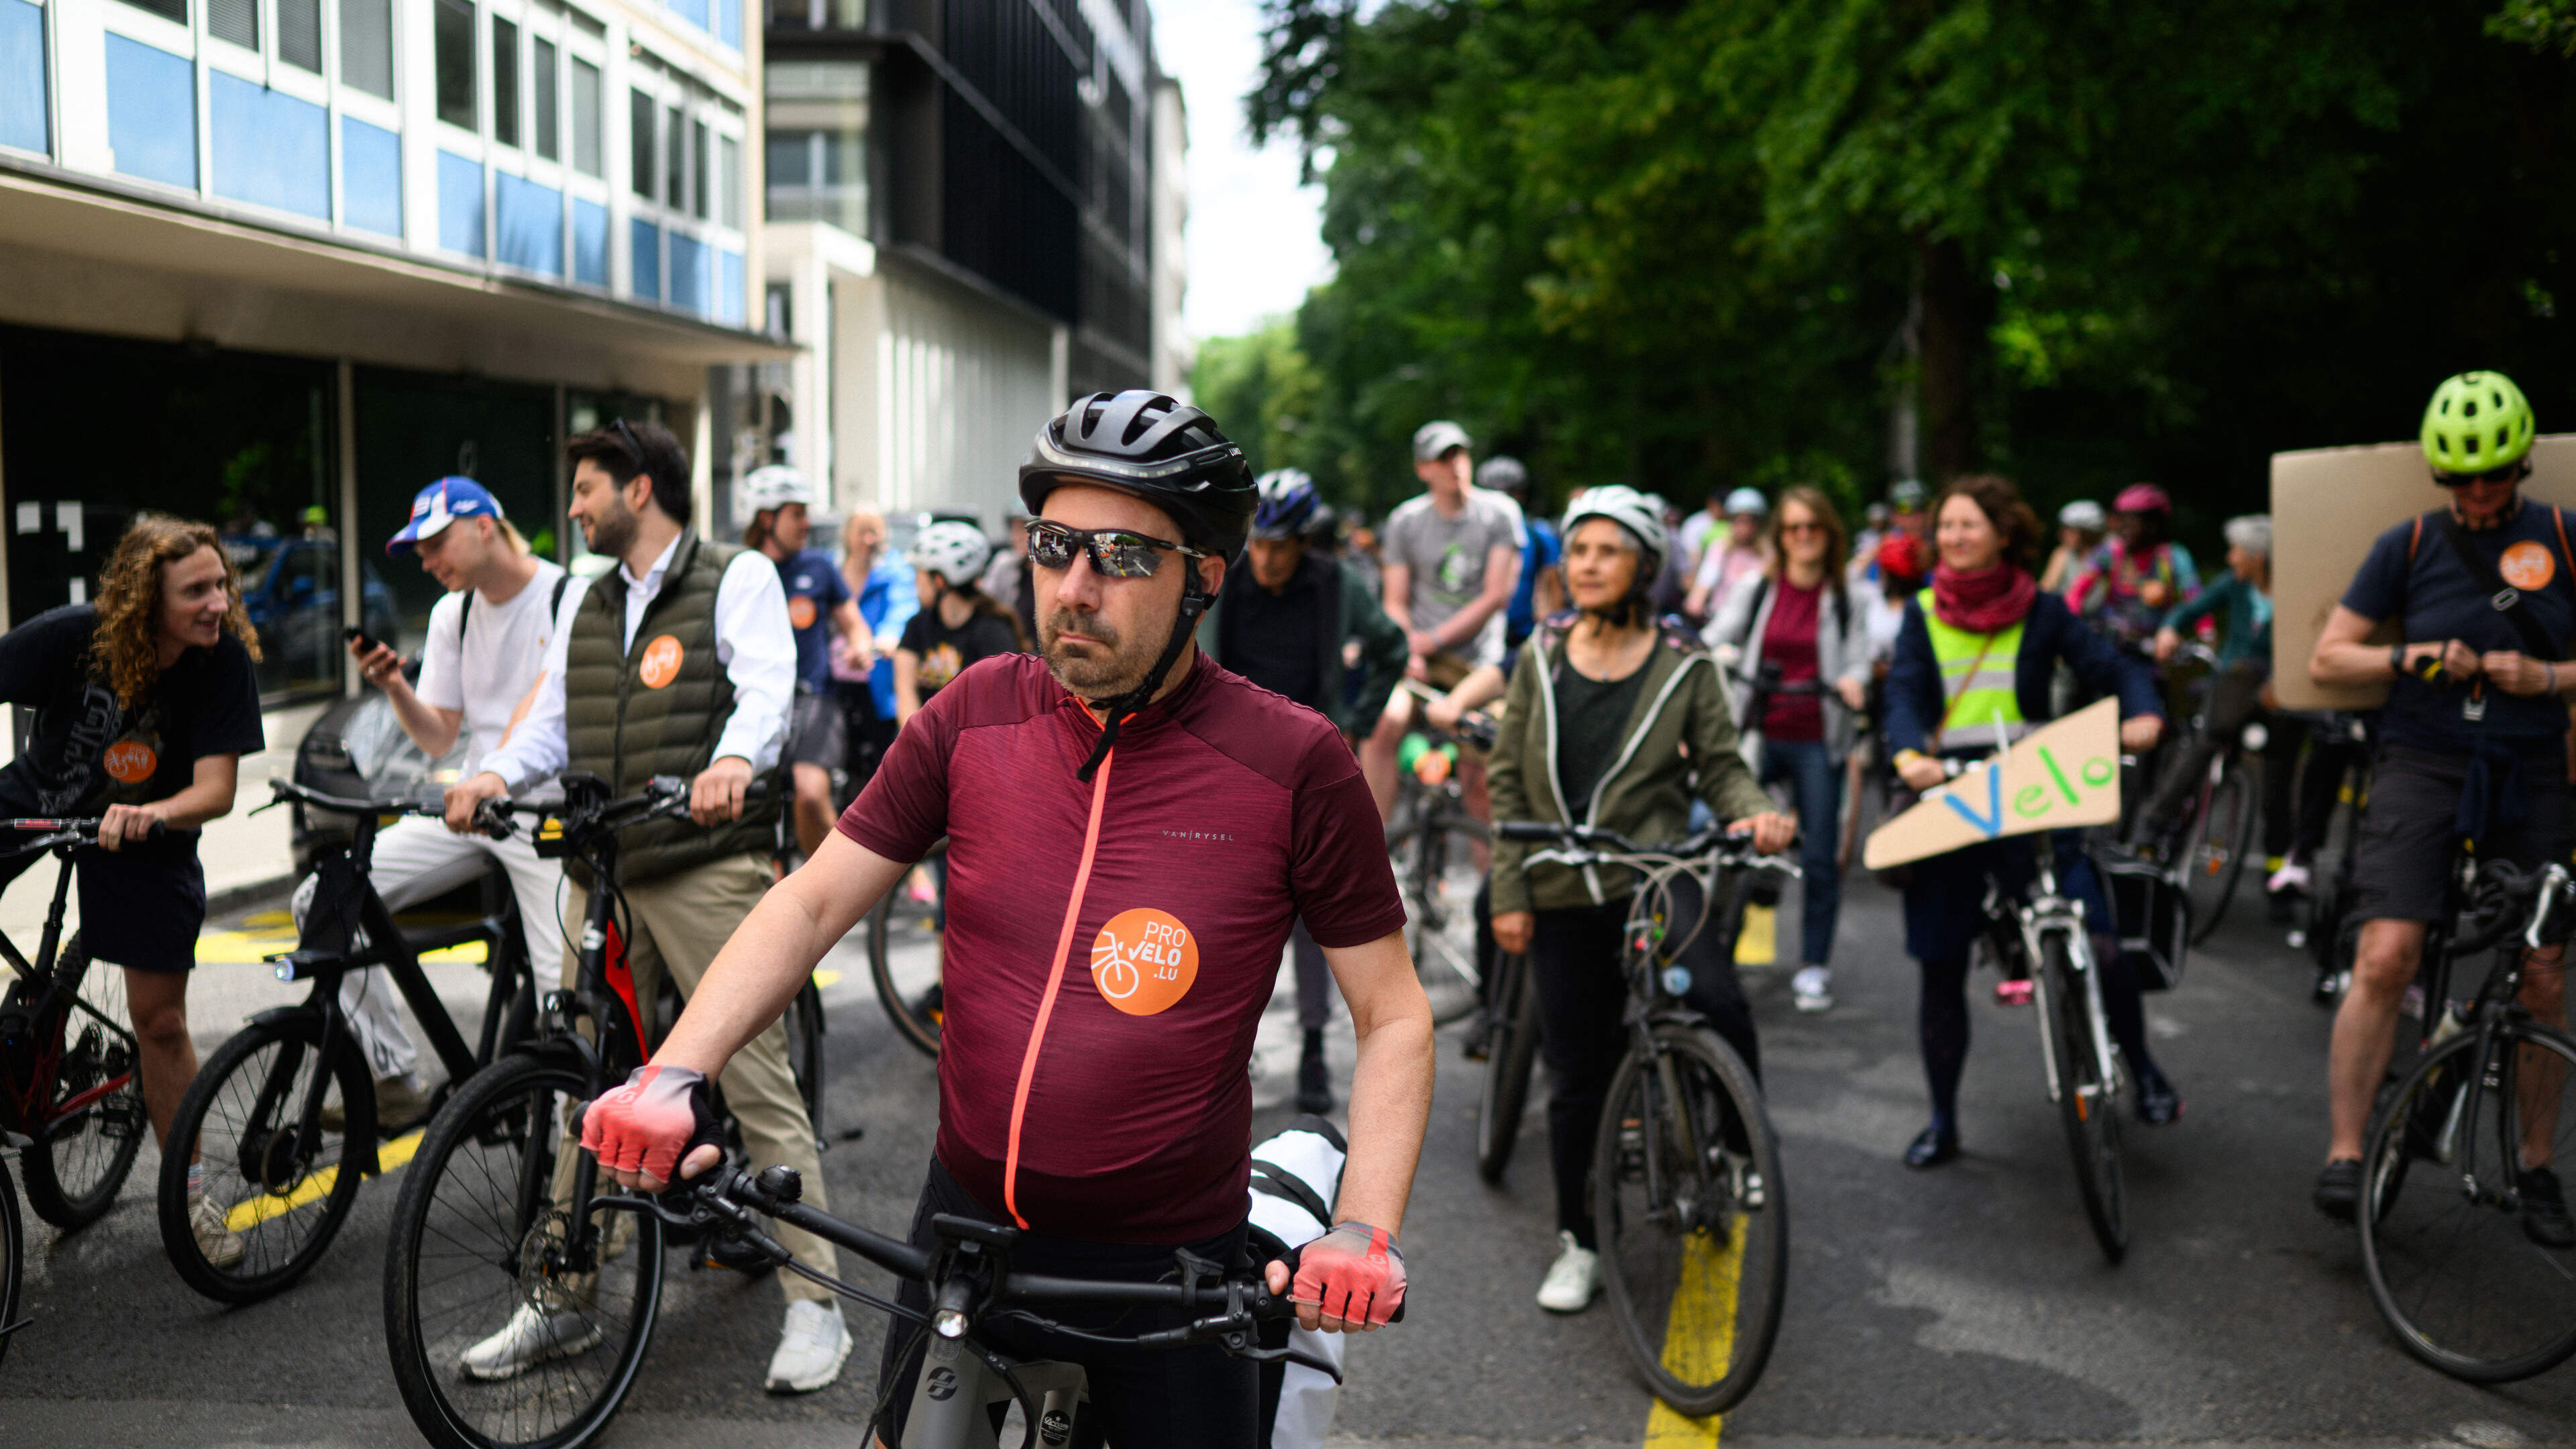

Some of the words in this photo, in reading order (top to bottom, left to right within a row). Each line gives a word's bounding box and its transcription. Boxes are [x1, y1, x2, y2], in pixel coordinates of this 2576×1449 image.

[1944, 747, 2114, 837] Velo
[1195, 832, 1234, 841] RYSEL
[1144, 921, 1186, 947] PRO
[1128, 941, 1181, 967] VELO
[1153, 966, 1178, 981] .LU
